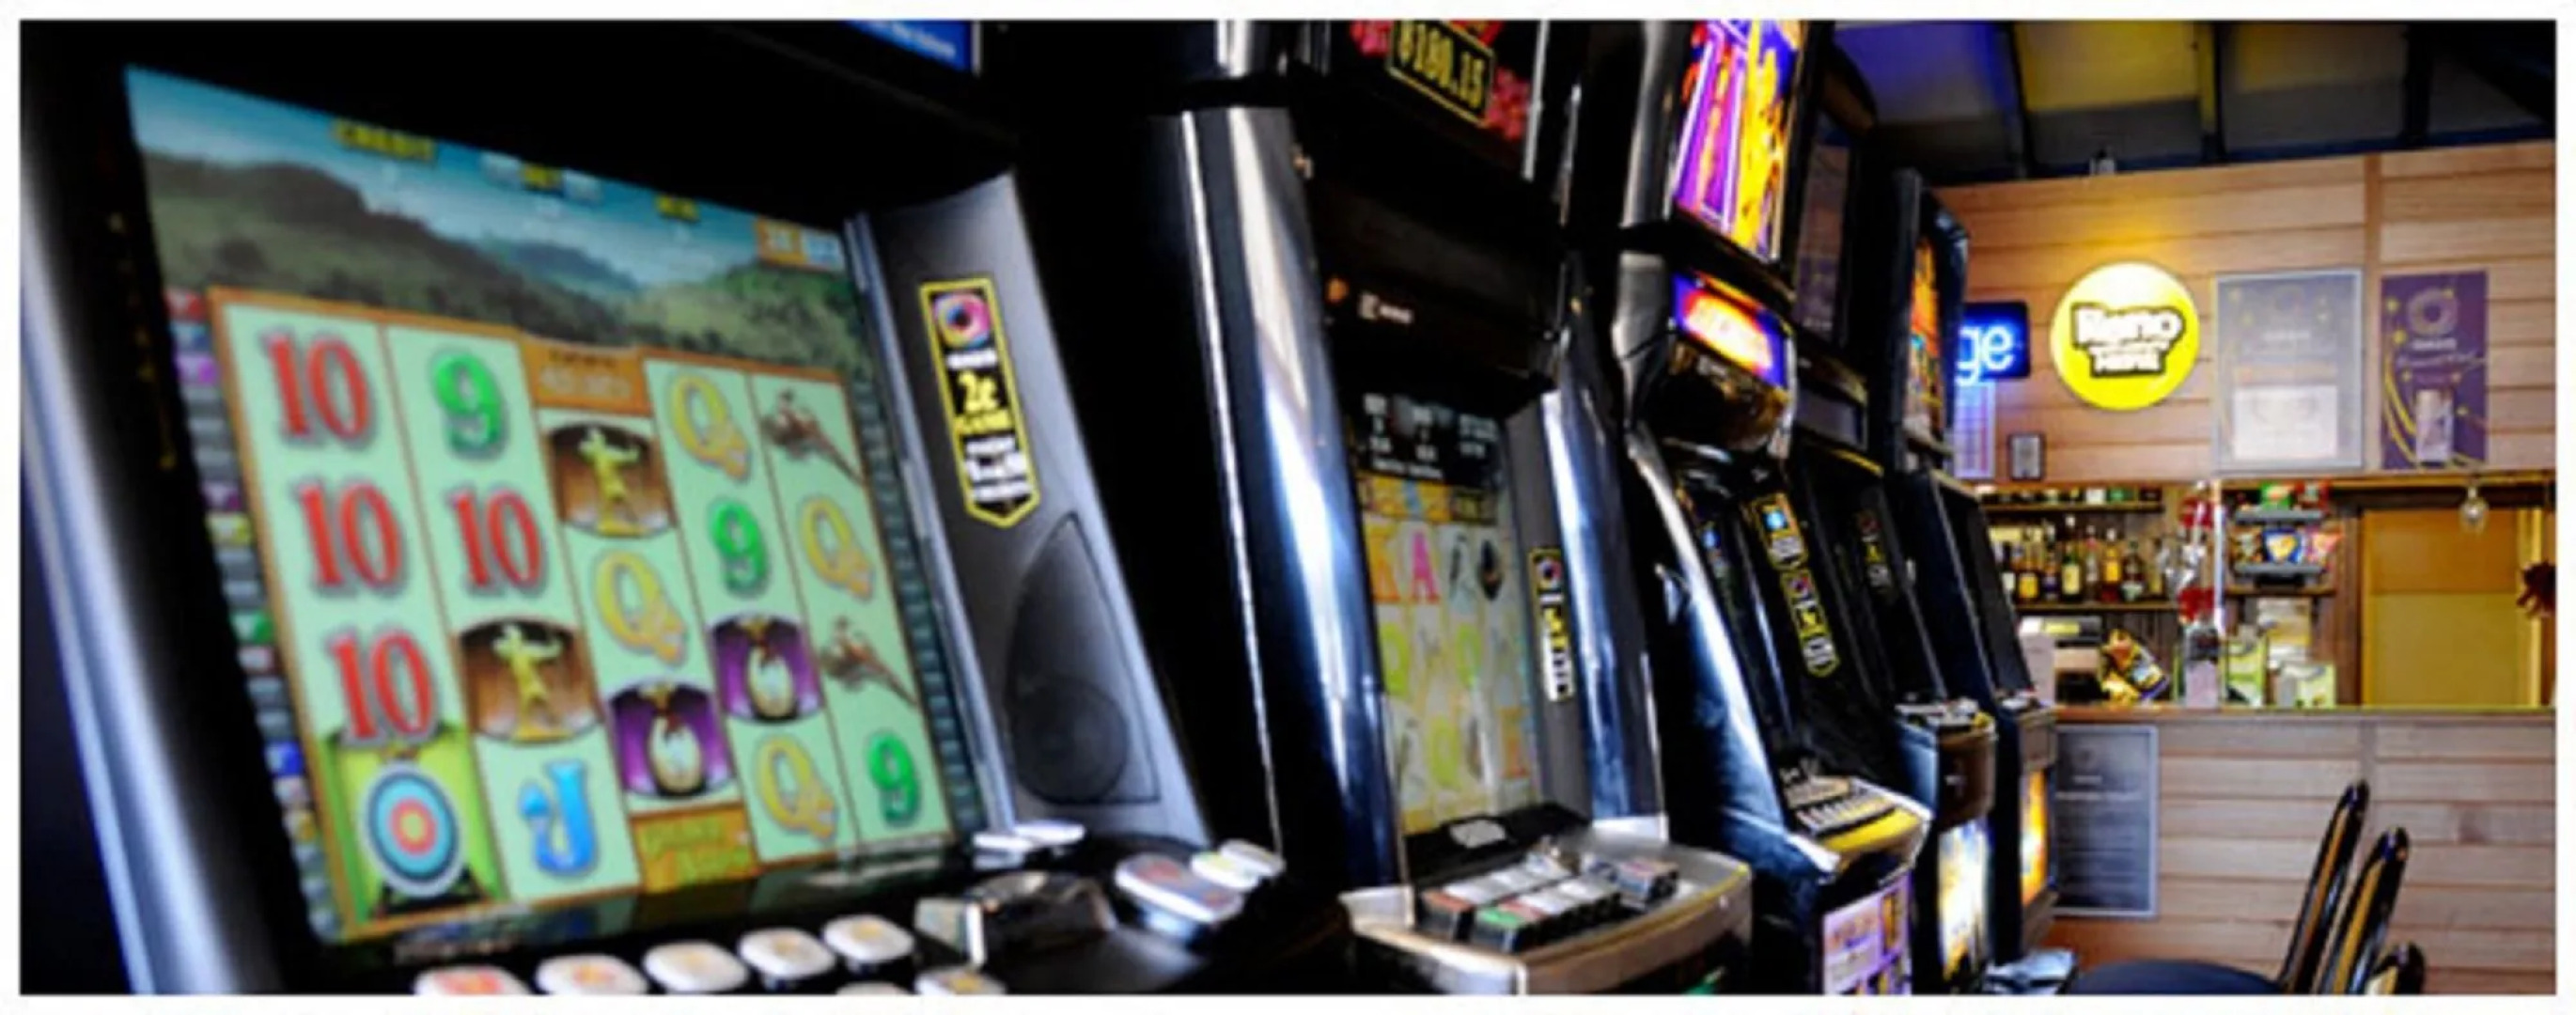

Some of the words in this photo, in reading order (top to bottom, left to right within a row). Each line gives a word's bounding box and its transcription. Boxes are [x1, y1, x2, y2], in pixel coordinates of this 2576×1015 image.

[259, 335, 371, 442] 10
[431, 349, 506, 455] 9
[666, 372, 752, 482] Q
[295, 479, 402, 590] 10
[451, 491, 543, 588] 10
[709, 498, 769, 594] 9
[798, 496, 876, 601] Q
[1412, 531, 1440, 603] A
[592, 550, 686, 664] Q
[331, 628, 435, 742] 10
[756, 737, 837, 842] Q
[868, 732, 923, 824] 9
